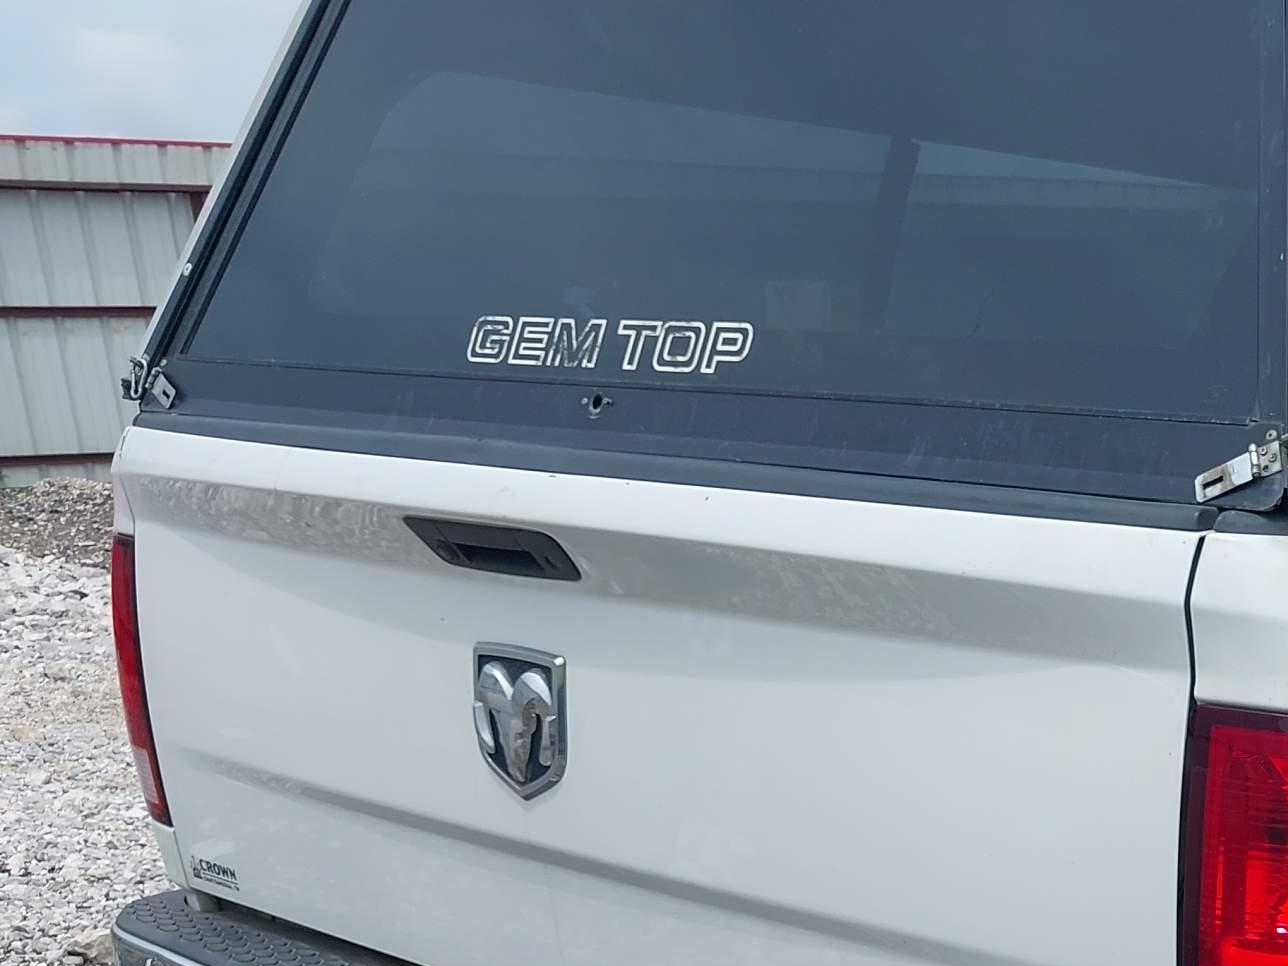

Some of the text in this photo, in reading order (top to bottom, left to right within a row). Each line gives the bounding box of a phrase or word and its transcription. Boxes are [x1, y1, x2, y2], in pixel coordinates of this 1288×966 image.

[467, 315, 754, 375] GEM TOP
[199, 859, 238, 881] CROWN
